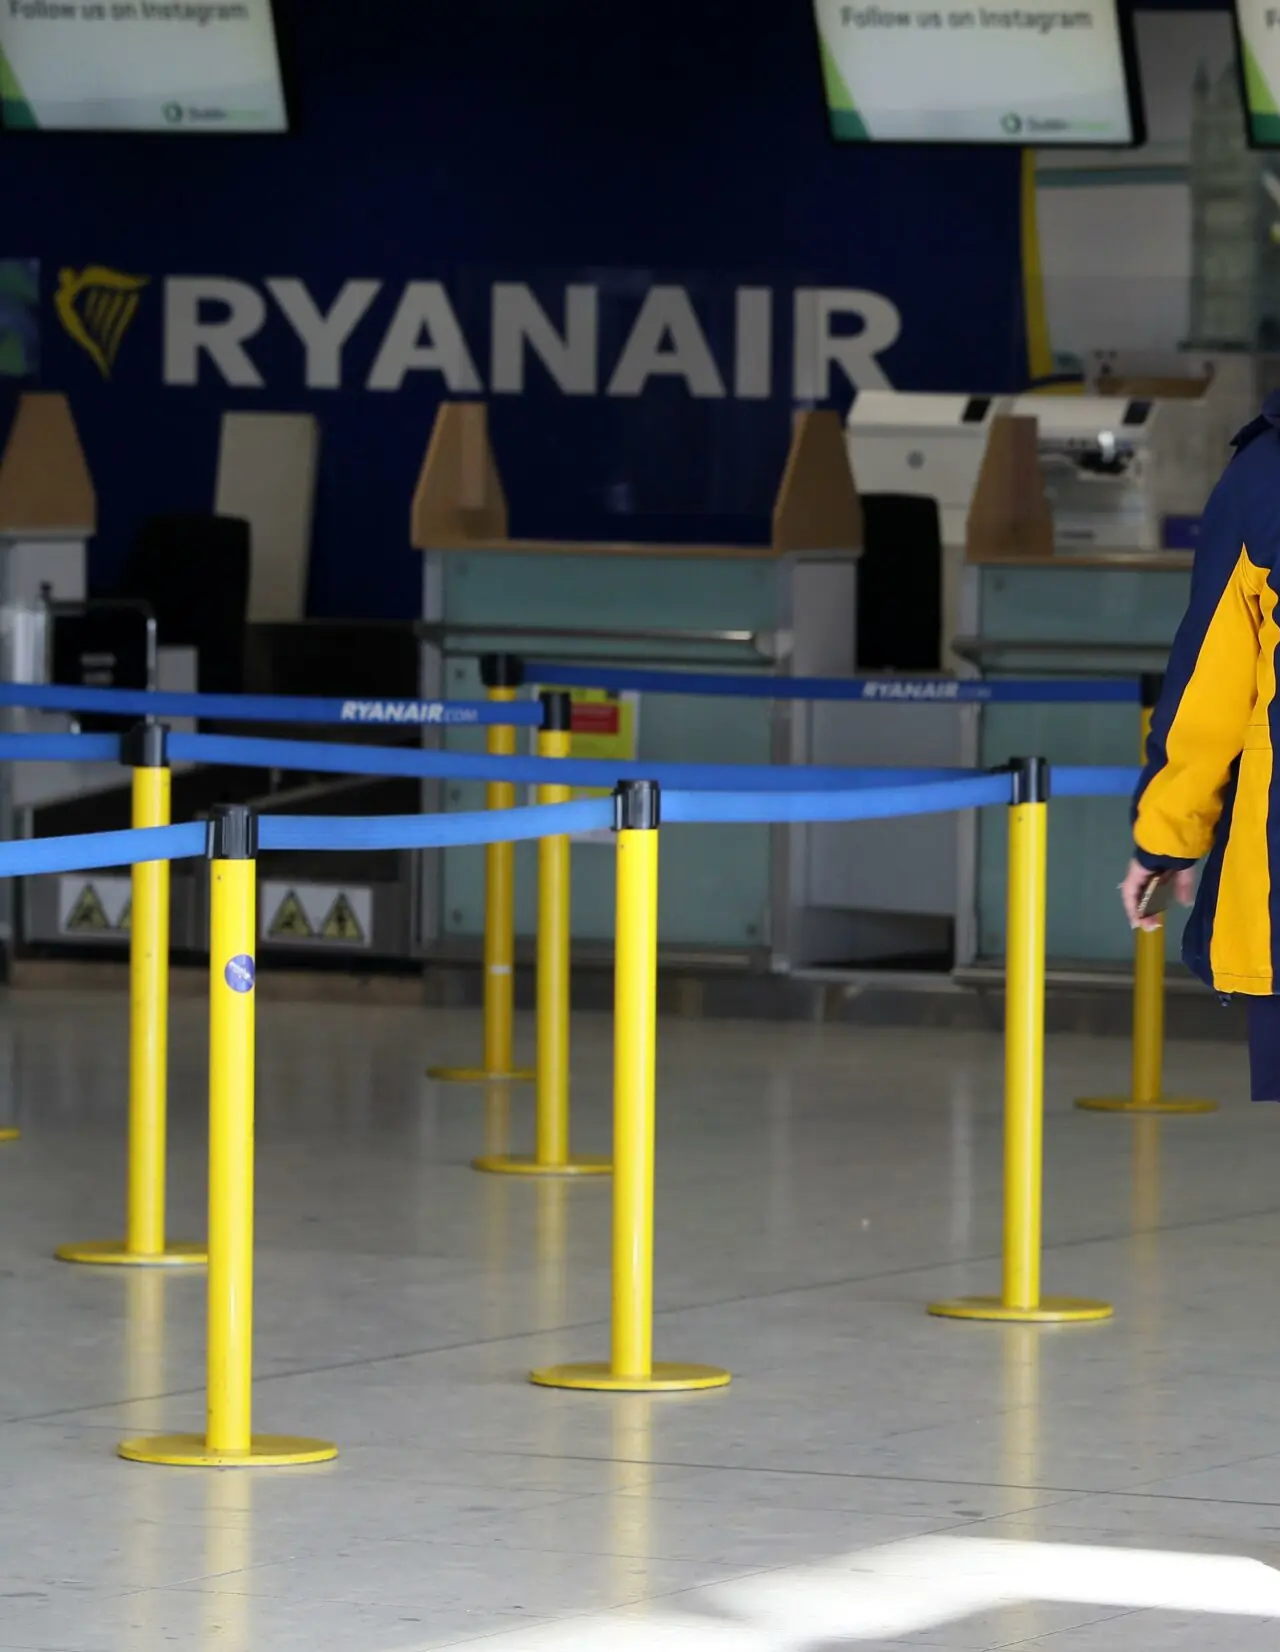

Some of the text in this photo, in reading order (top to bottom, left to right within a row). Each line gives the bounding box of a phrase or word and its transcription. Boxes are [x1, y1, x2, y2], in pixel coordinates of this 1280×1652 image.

[9, 1, 249, 26] Follow us on Instagram
[840, 6, 1093, 34] Follow us on Instagram
[162, 275, 902, 400] RYANAIR
